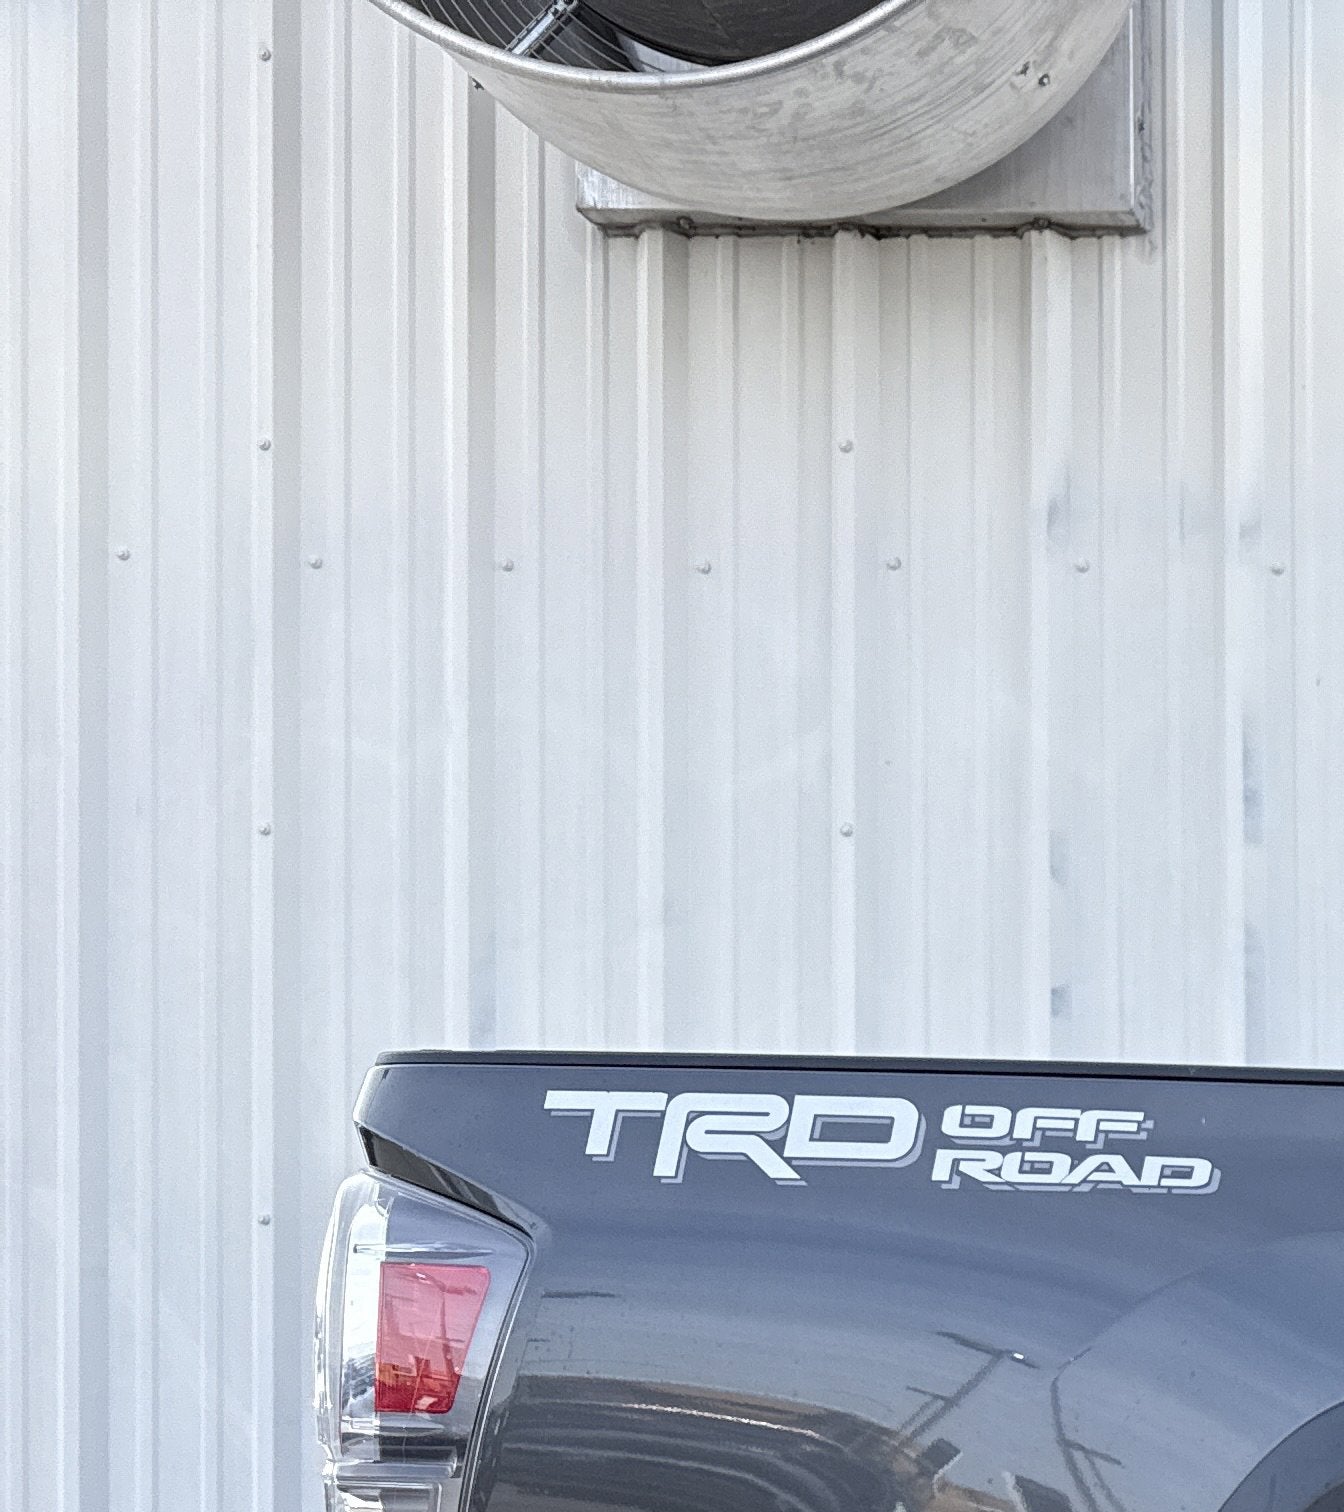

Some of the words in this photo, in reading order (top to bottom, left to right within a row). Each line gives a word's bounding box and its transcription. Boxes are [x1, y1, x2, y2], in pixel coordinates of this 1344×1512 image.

[543, 1089, 928, 1186] TRD
[941, 1103, 1154, 1149] OFF
[931, 1148, 1222, 1195] ROAD
